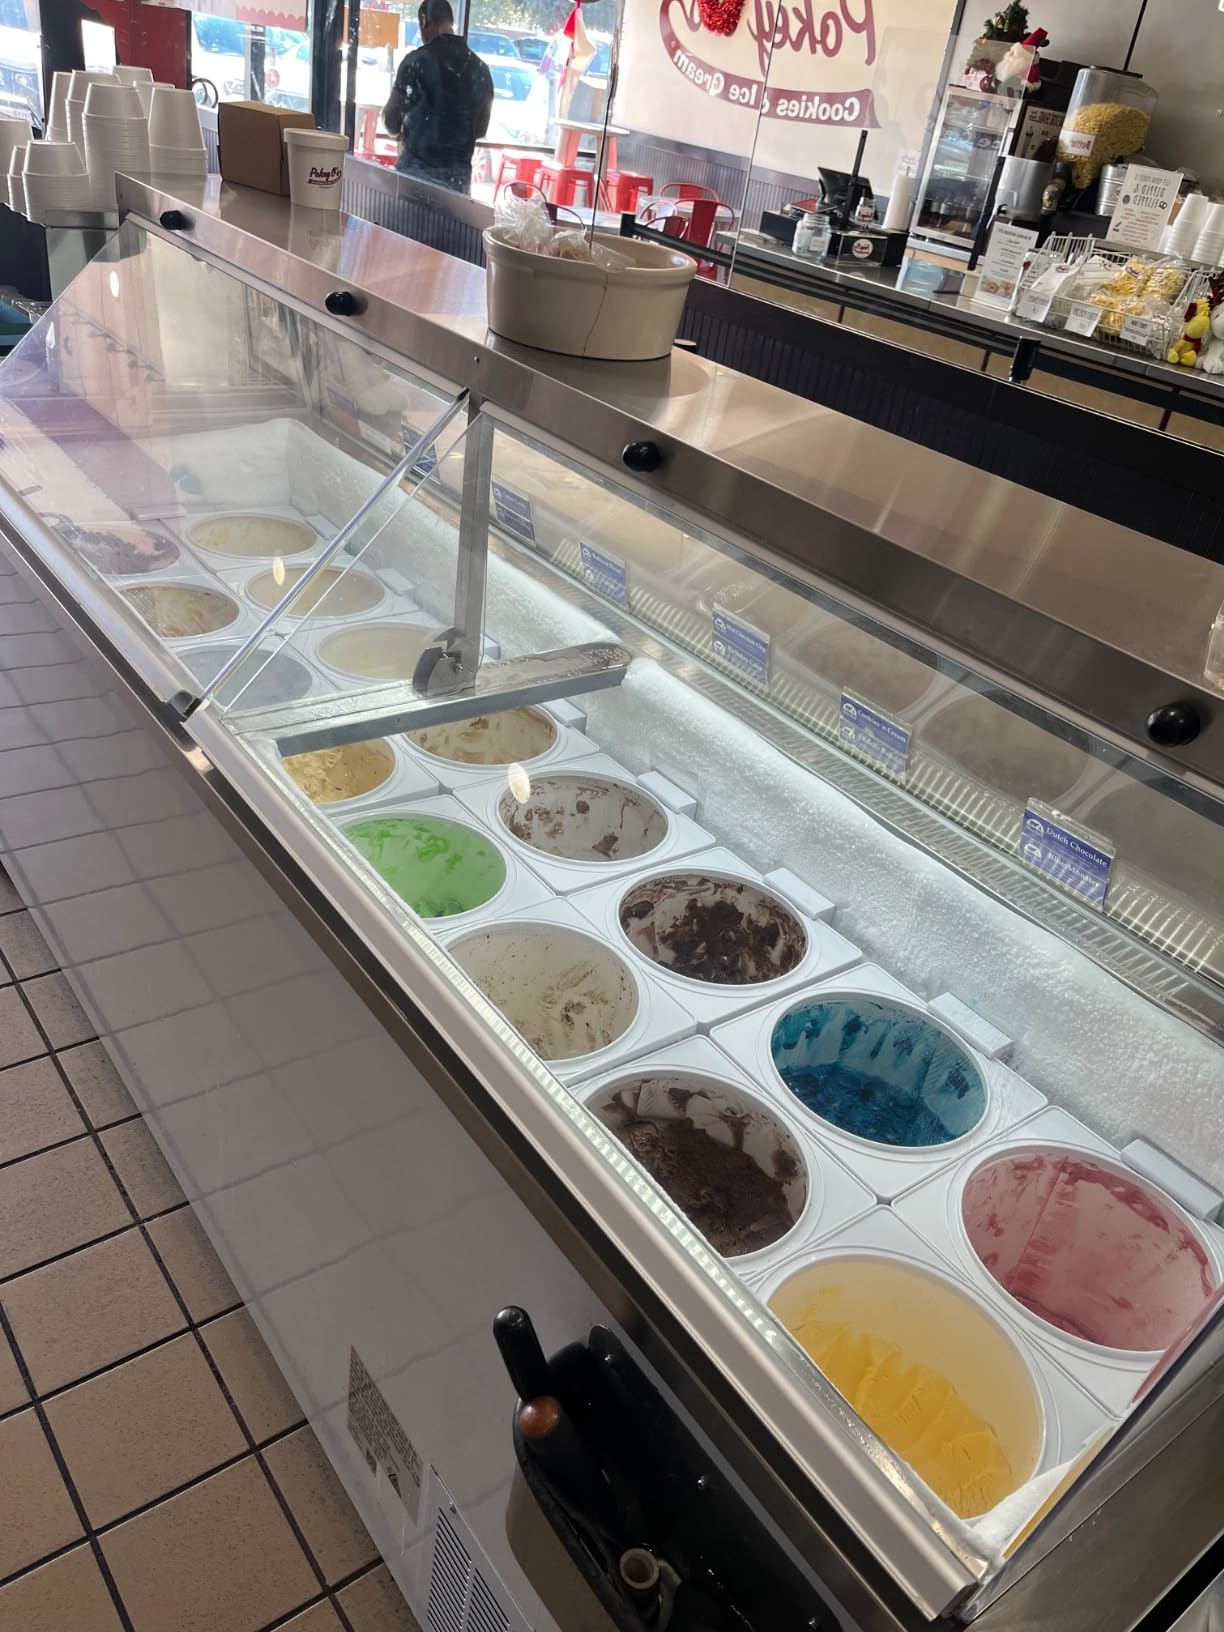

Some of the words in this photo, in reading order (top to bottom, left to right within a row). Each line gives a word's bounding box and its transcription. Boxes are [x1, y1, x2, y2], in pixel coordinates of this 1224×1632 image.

[858, 709, 880, 727] Cookies
[887, 727, 906, 743] Cream
[1046, 827, 1069, 846] Dutch
[1070, 841, 1107, 867] Chocolate
[1048, 852, 1067, 868] Blue
[1066, 861, 1100, 887] Monster
